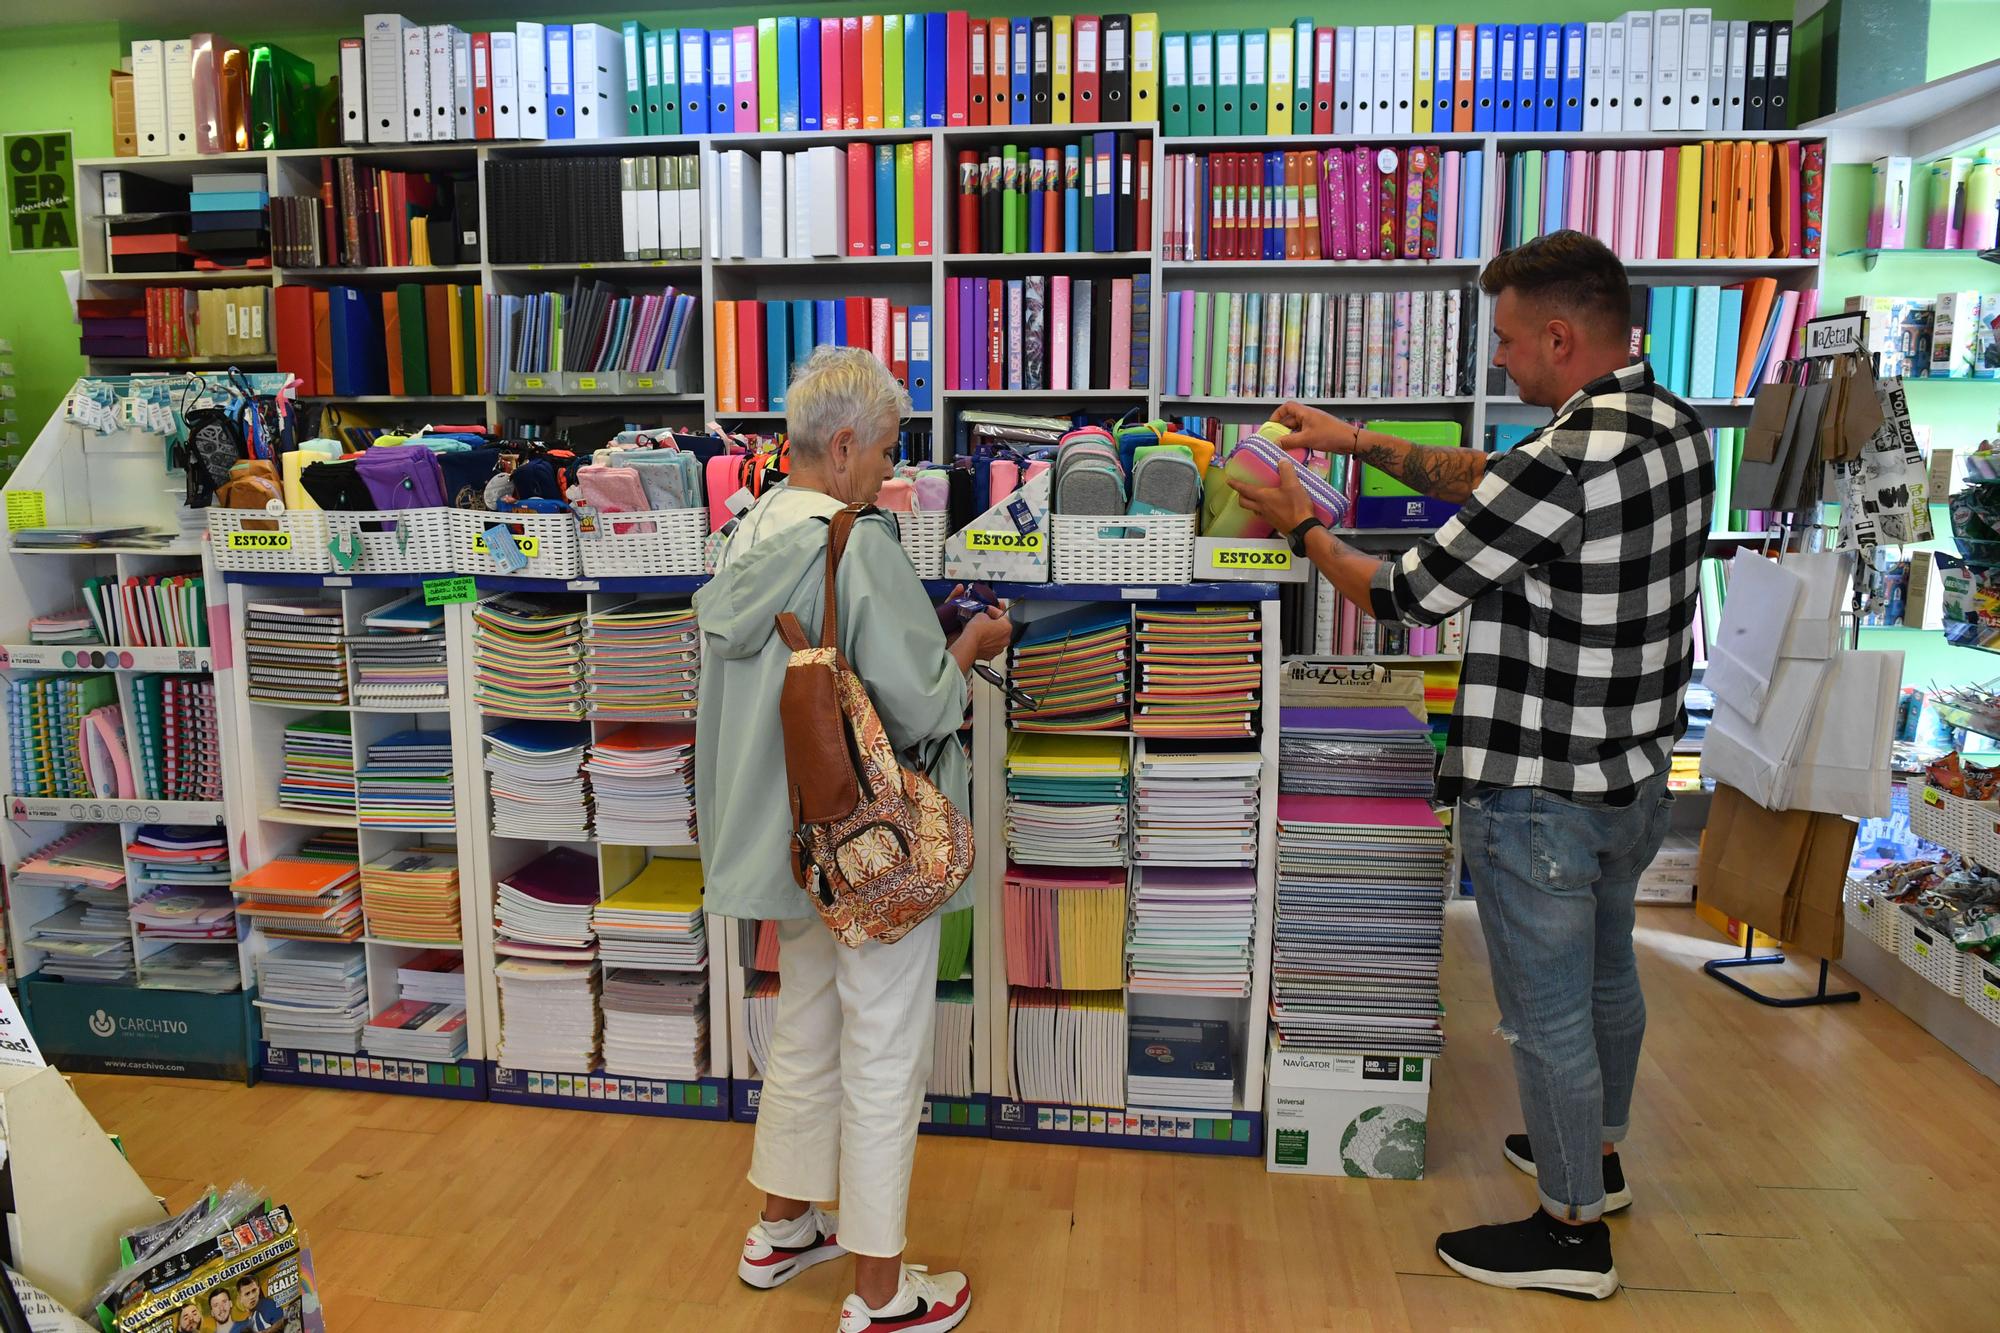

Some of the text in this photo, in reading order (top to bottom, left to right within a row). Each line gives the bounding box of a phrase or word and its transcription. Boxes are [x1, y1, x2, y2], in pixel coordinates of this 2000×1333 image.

[10, 135, 66, 174] OF
[14, 173, 69, 209] ER
[14, 211, 73, 249] TA
[1629, 328, 1642, 355] REPLAY
[233, 535, 288, 546] ESTOXO
[972, 533, 1039, 547] ESTOXO
[1219, 552, 1287, 564] ESTOXO
[15, 806, 26, 815] A4
[119, 1017, 188, 1034] CARCHIVO
[104, 1060, 185, 1072] www.carchivo.com
[1283, 1058, 1330, 1069] NAVIGATOR
[1365, 1060, 1380, 1068] UHD
[1405, 1064, 1416, 1073] 80
[1277, 1097, 1305, 1106] Universal
[207, 1274, 220, 1287] DE
[220, 1259, 251, 1280] CARTAS
[251, 1253, 264, 1266] DE
[267, 1271, 299, 1296] REALES
